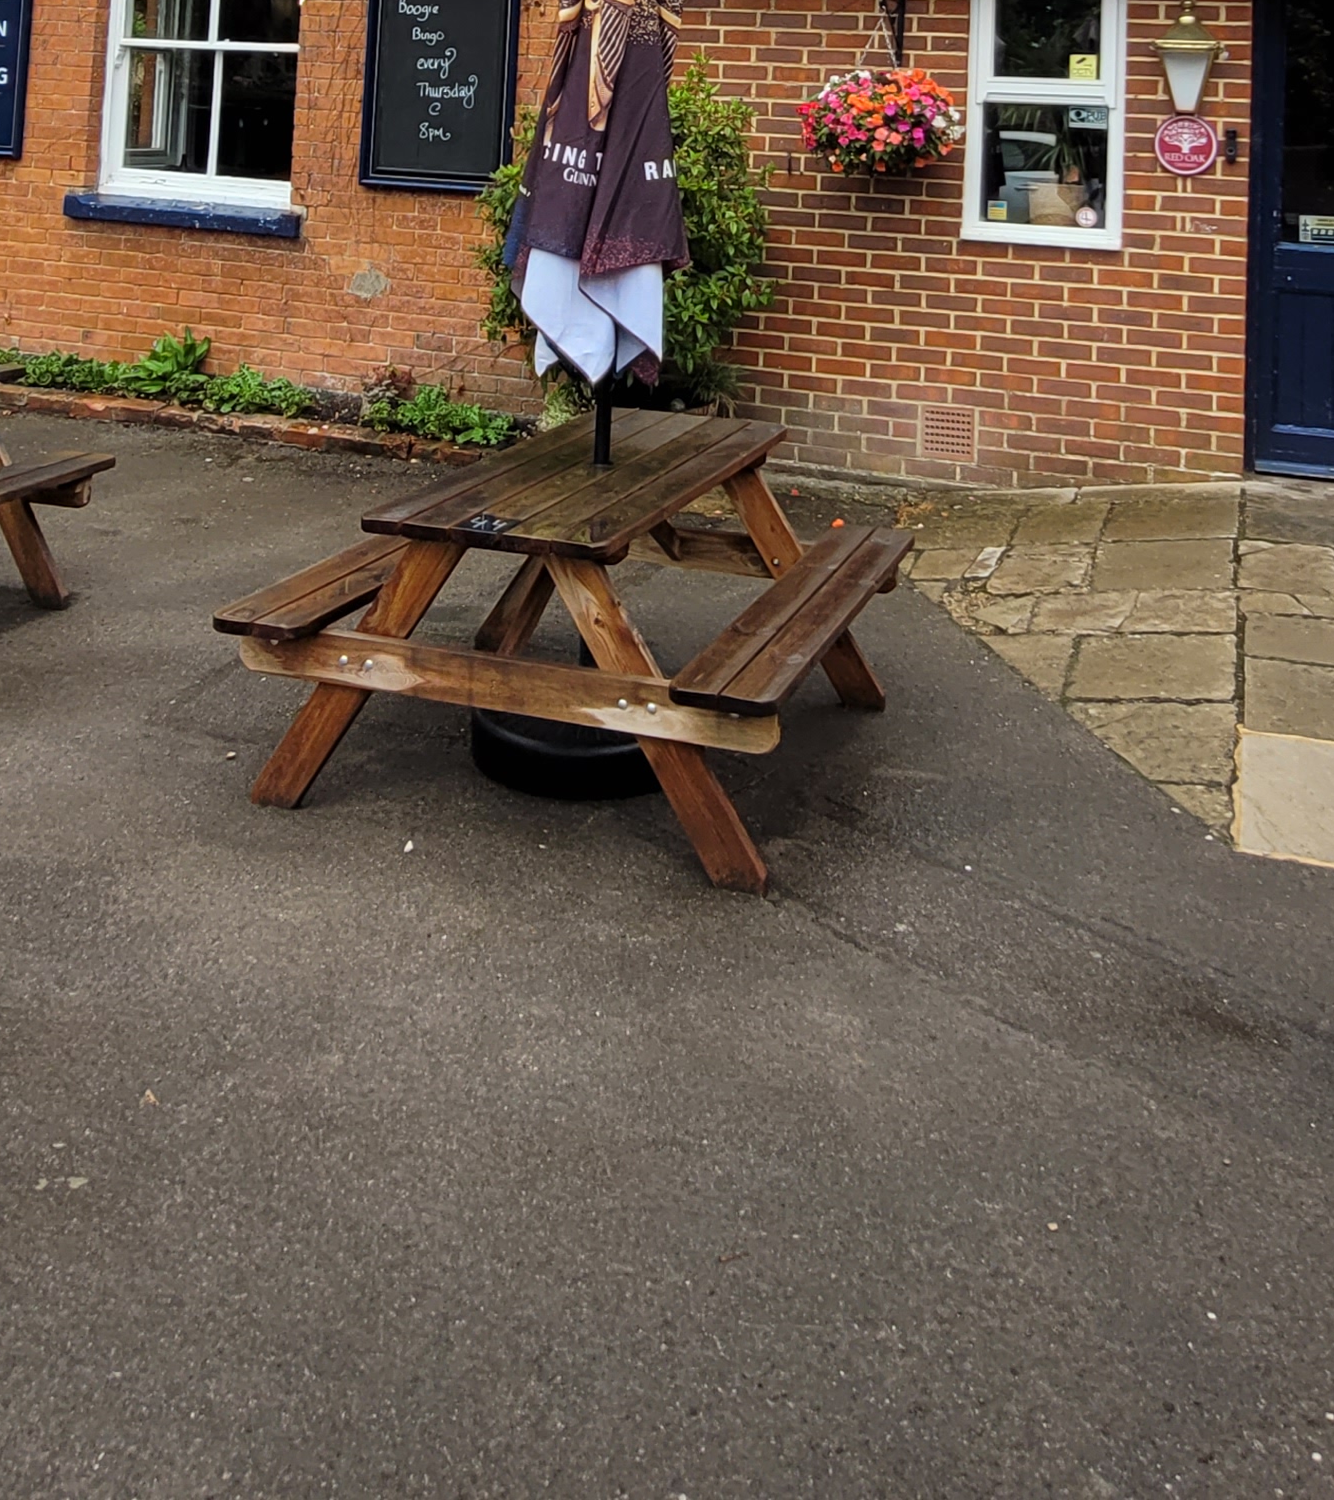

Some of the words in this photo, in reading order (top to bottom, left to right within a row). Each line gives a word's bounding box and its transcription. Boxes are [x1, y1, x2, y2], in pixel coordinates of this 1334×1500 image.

[411, 26, 445, 47] Bingo
[416, 47, 457, 80] every
[415, 74, 479, 110] Thursday
[1164, 152, 1184, 162] RED
[1184, 153, 1207, 163] OAK
